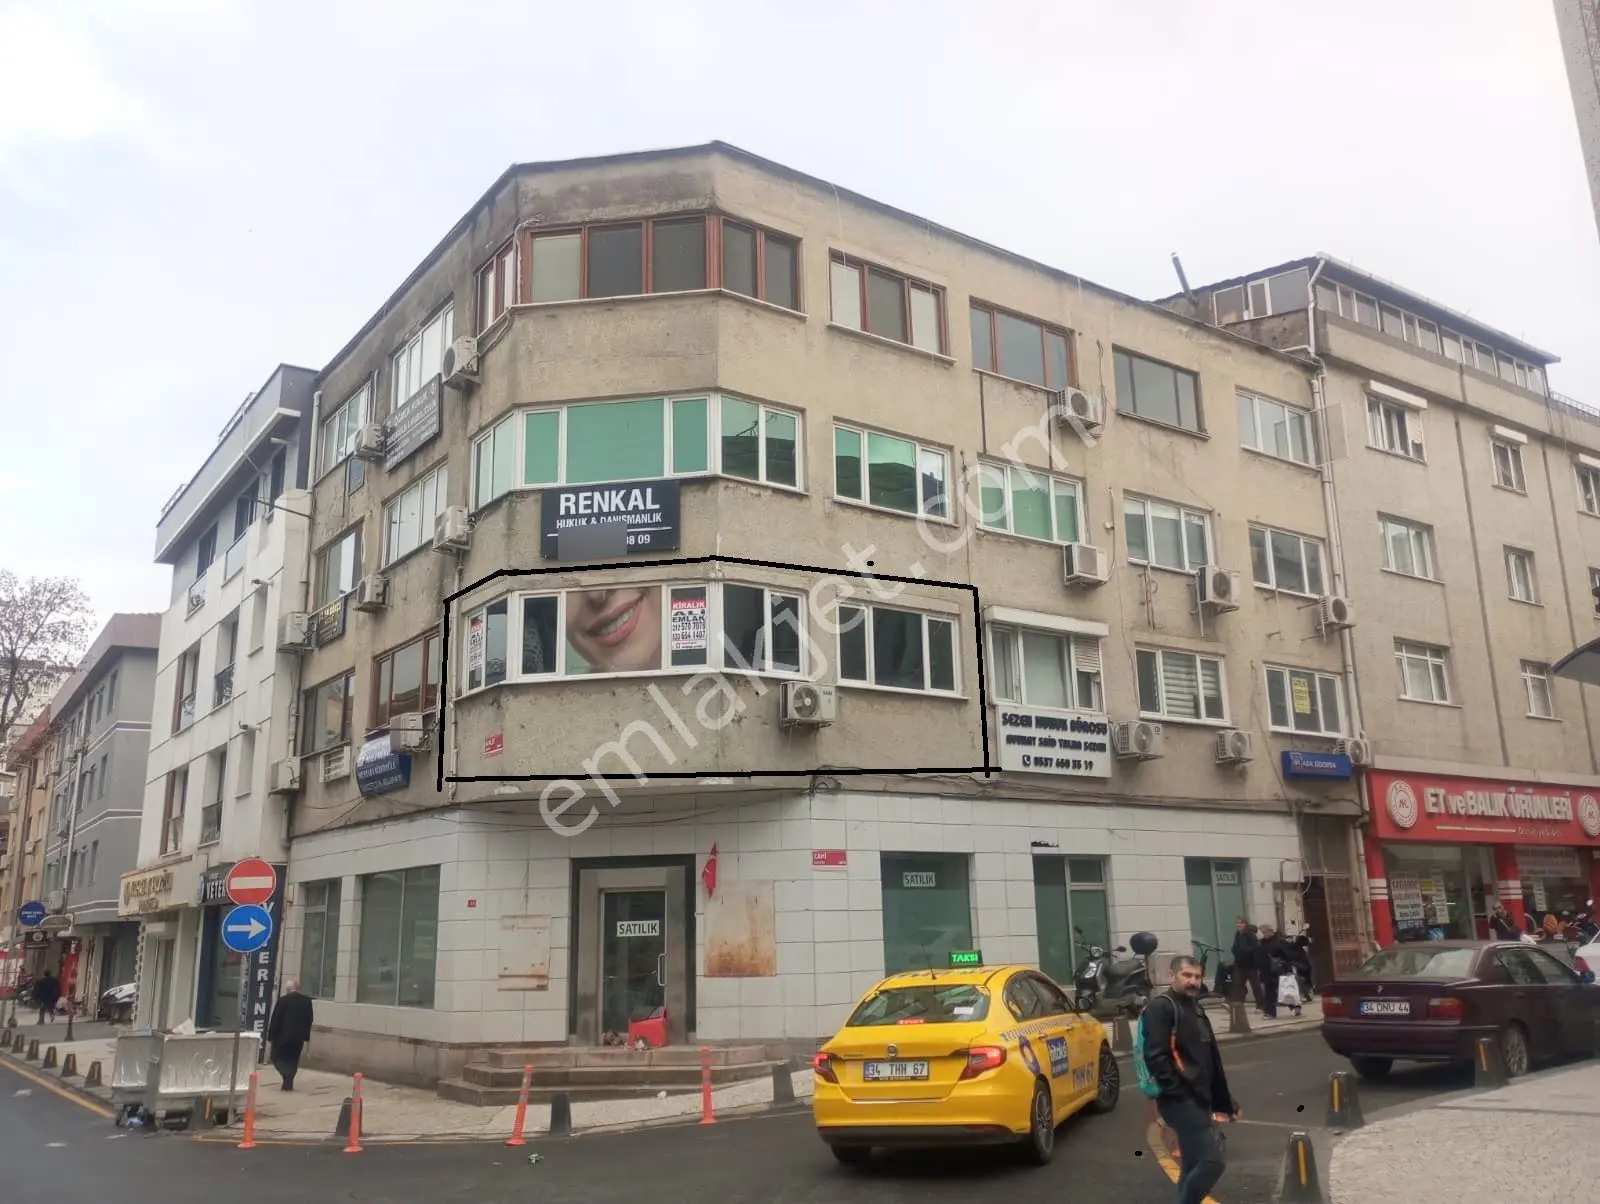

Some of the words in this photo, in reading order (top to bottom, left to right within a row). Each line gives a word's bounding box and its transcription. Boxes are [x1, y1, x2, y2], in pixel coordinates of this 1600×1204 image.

[560, 488, 660, 515] RENKAL
[556, 519, 587, 528] HUKUK
[638, 535, 650, 544] 09
[1424, 787, 1447, 814] ET
[1507, 787, 1574, 822] ÜRÜNLERİ
[903, 873, 936, 887] SATILIK
[618, 922, 658, 935] SATILIK
[951, 952, 979, 963] TAKSİ
[1364, 1002, 1374, 1013] 34
[1397, 1003, 1410, 1014] 44
[889, 1063, 907, 1076] THH
[913, 1063, 925, 1075] 67
